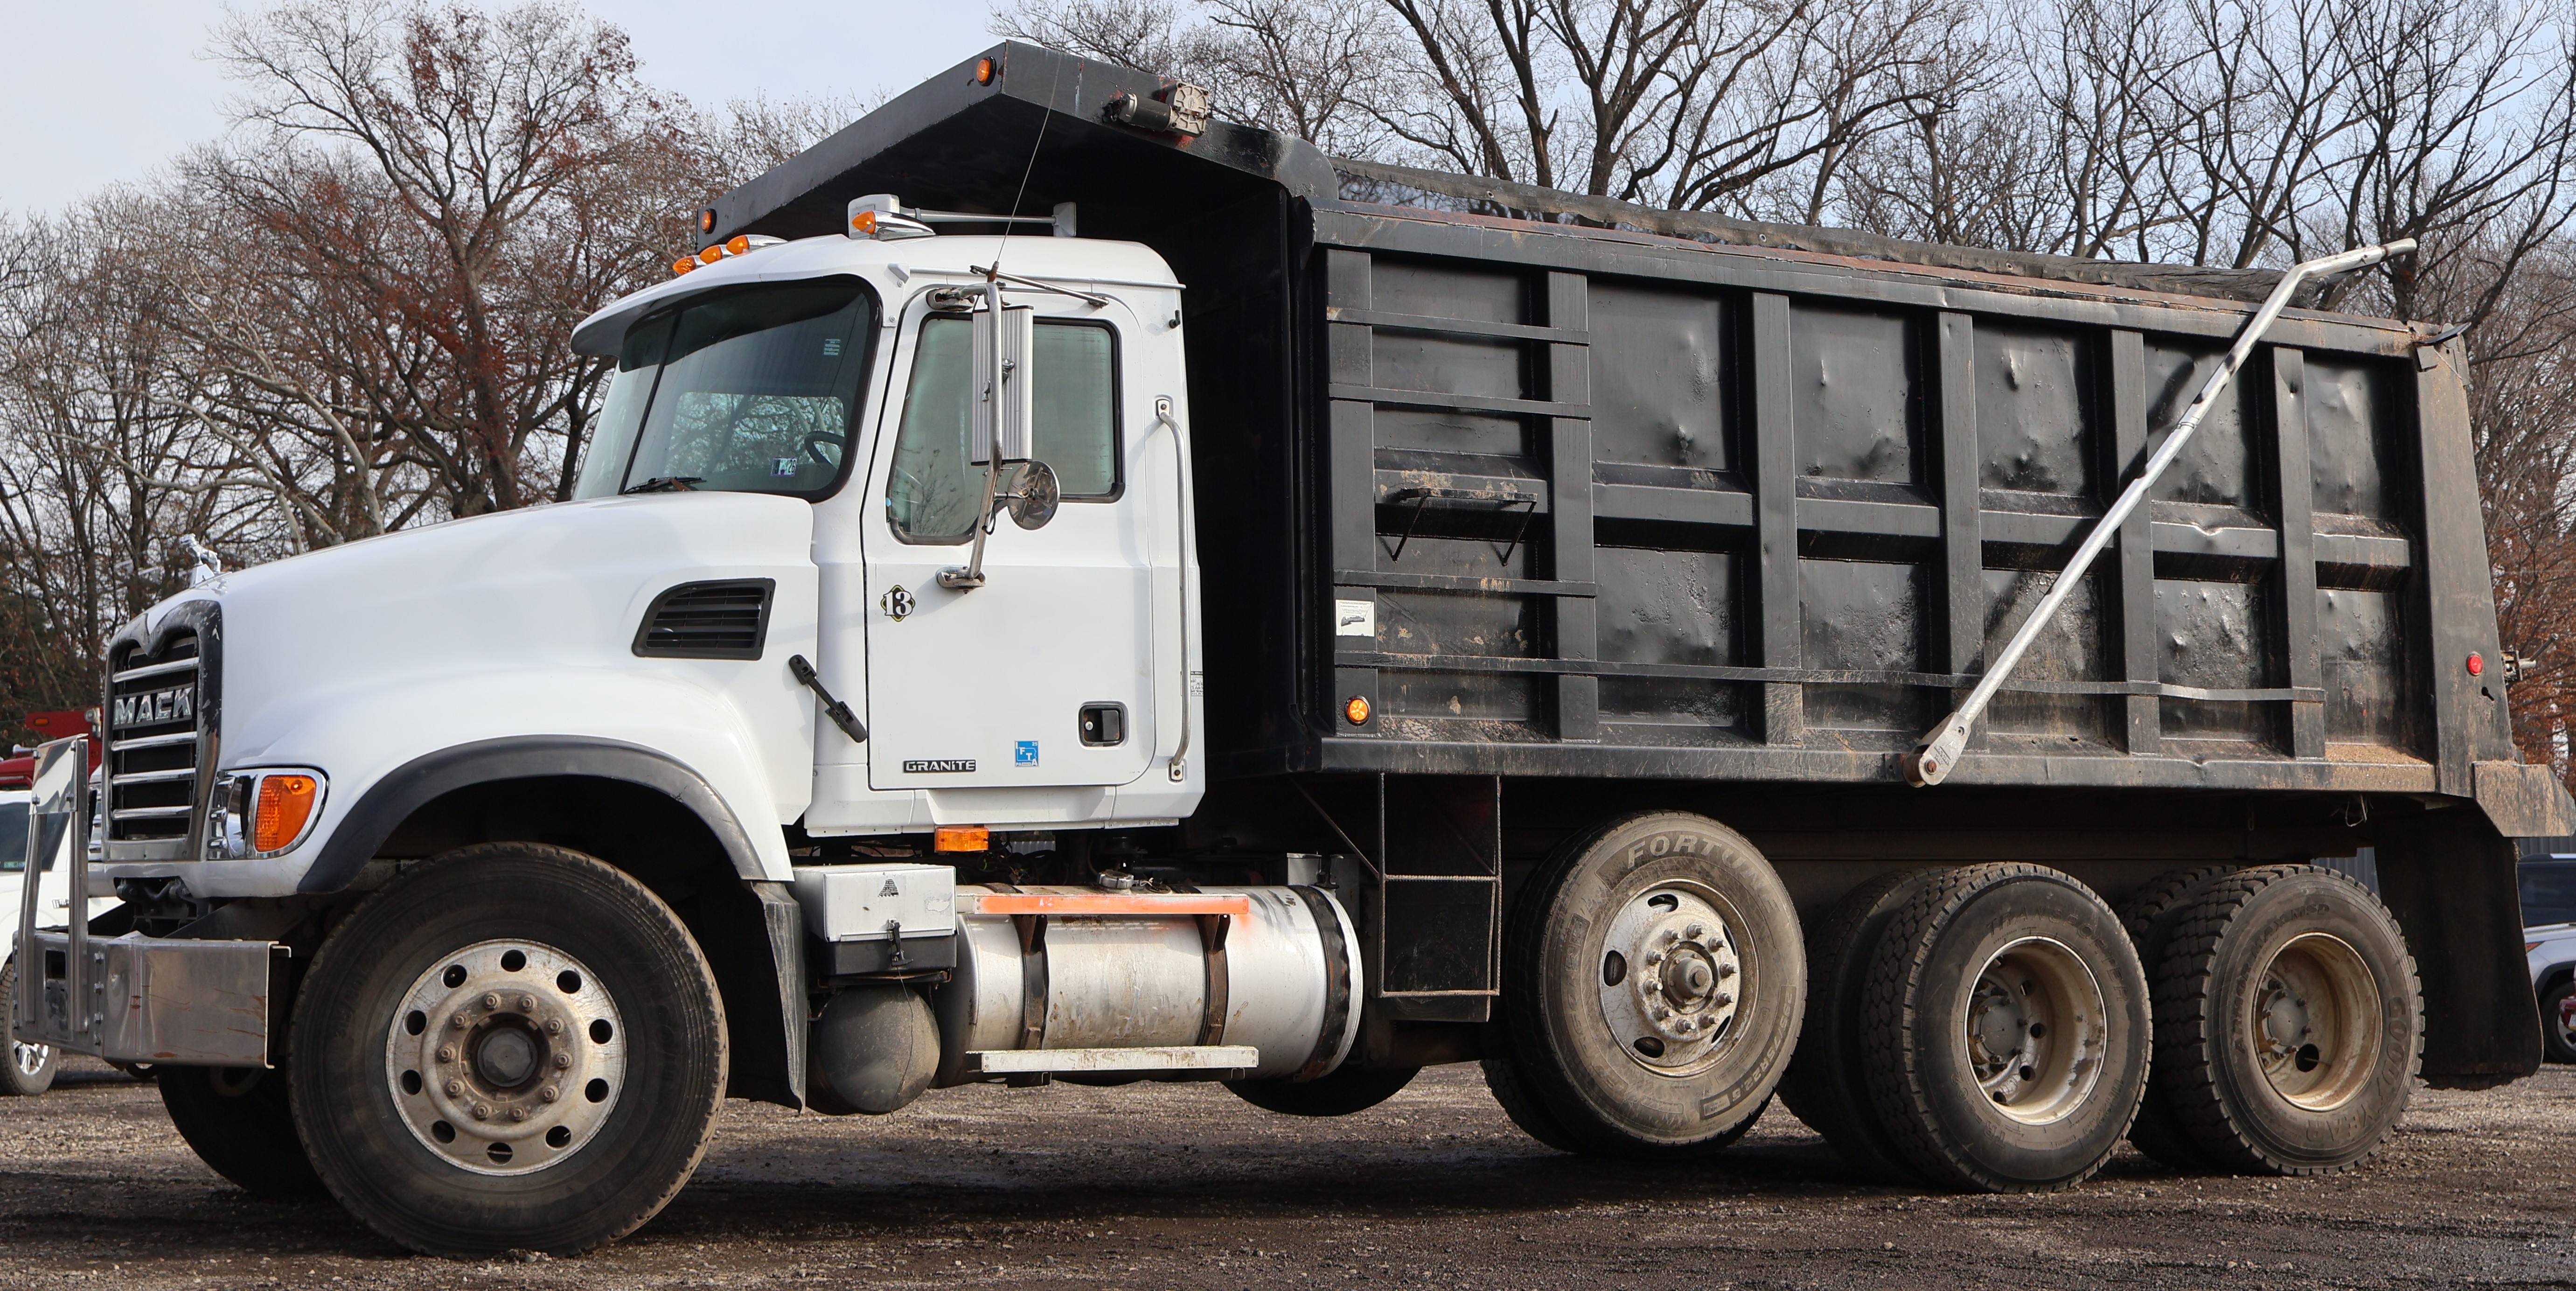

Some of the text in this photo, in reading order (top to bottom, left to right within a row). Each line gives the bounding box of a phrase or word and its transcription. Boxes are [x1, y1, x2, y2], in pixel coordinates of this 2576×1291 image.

[883, 590, 913, 616] 13
[113, 687, 193, 725] MACK
[906, 761, 975, 771] GRANITE
[1627, 835, 1783, 914] FORTUNE
